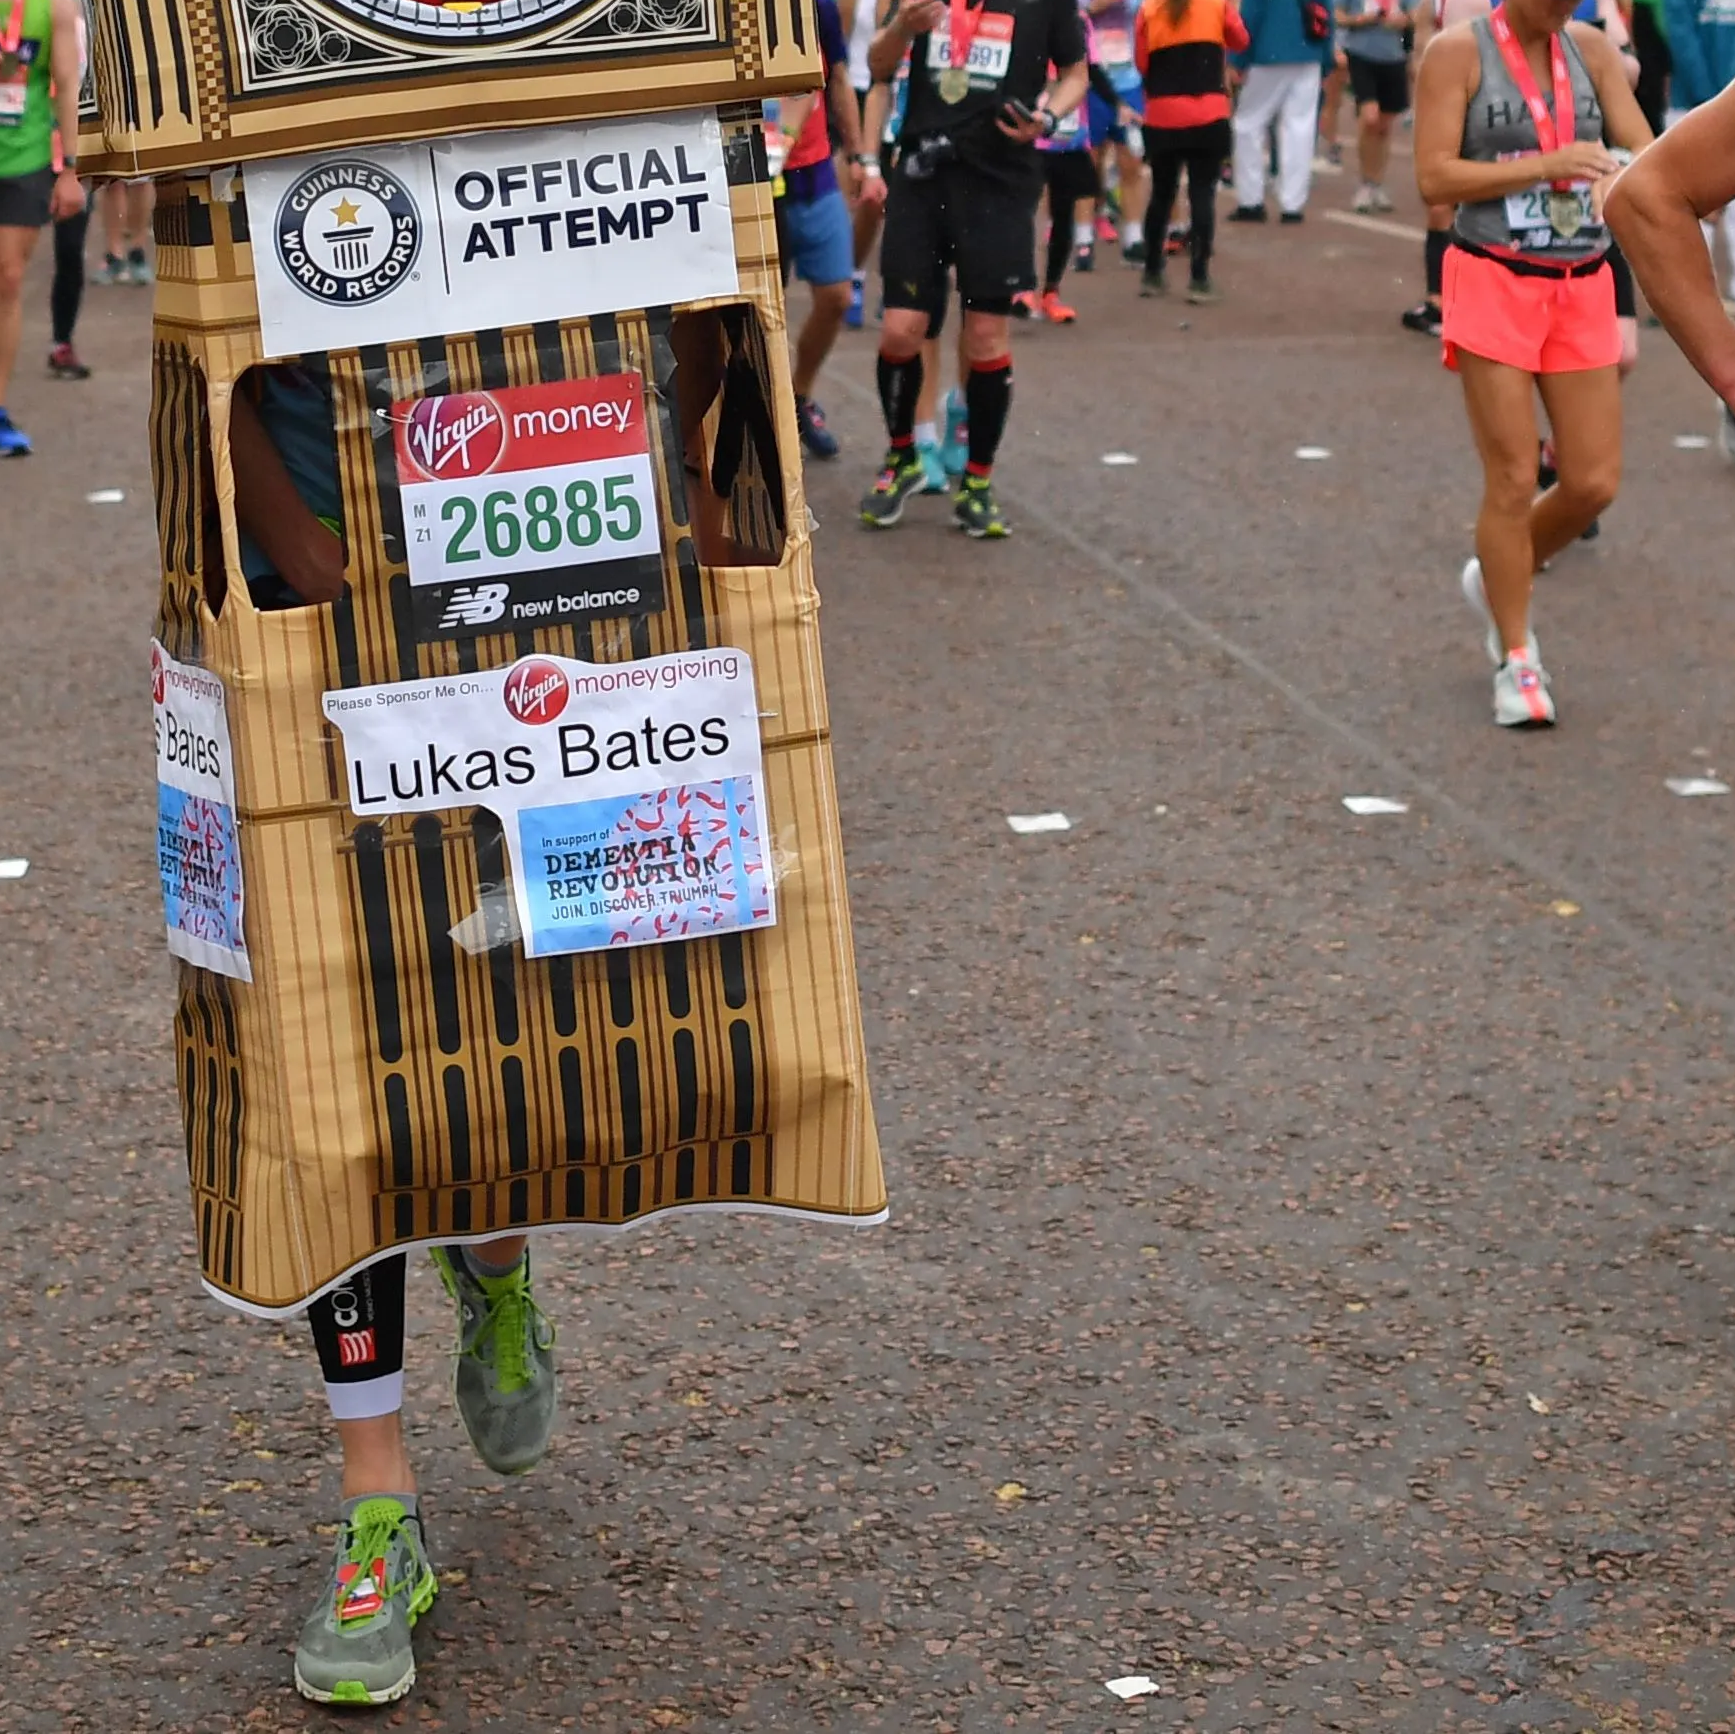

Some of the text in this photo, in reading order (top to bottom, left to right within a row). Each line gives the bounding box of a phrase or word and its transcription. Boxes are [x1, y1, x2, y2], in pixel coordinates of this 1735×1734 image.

[291, 168, 397, 212] GUINNESS
[454, 144, 707, 211] OFFICIAL
[463, 192, 709, 263] ATTEMPT
[283, 215, 413, 298] WORLD RECORDS
[413, 396, 633, 471] Virgin money
[413, 503, 426, 518] M
[440, 473, 642, 564] 26885
[416, 527, 432, 543] Z1
[512, 598, 553, 619] new
[557, 587, 641, 613] balance
[327, 698, 373, 712] Please
[376, 689, 431, 707] Sponsor
[435, 685, 456, 698] Me
[509, 667, 564, 716] Virgin
[165, 709, 221, 779] Bates
[354, 716, 730, 805] Lukas Bates
[542, 828, 610, 848] In support of
[544, 832, 696, 876] DEMENTIA
[547, 854, 722, 901] REVOLUTION
